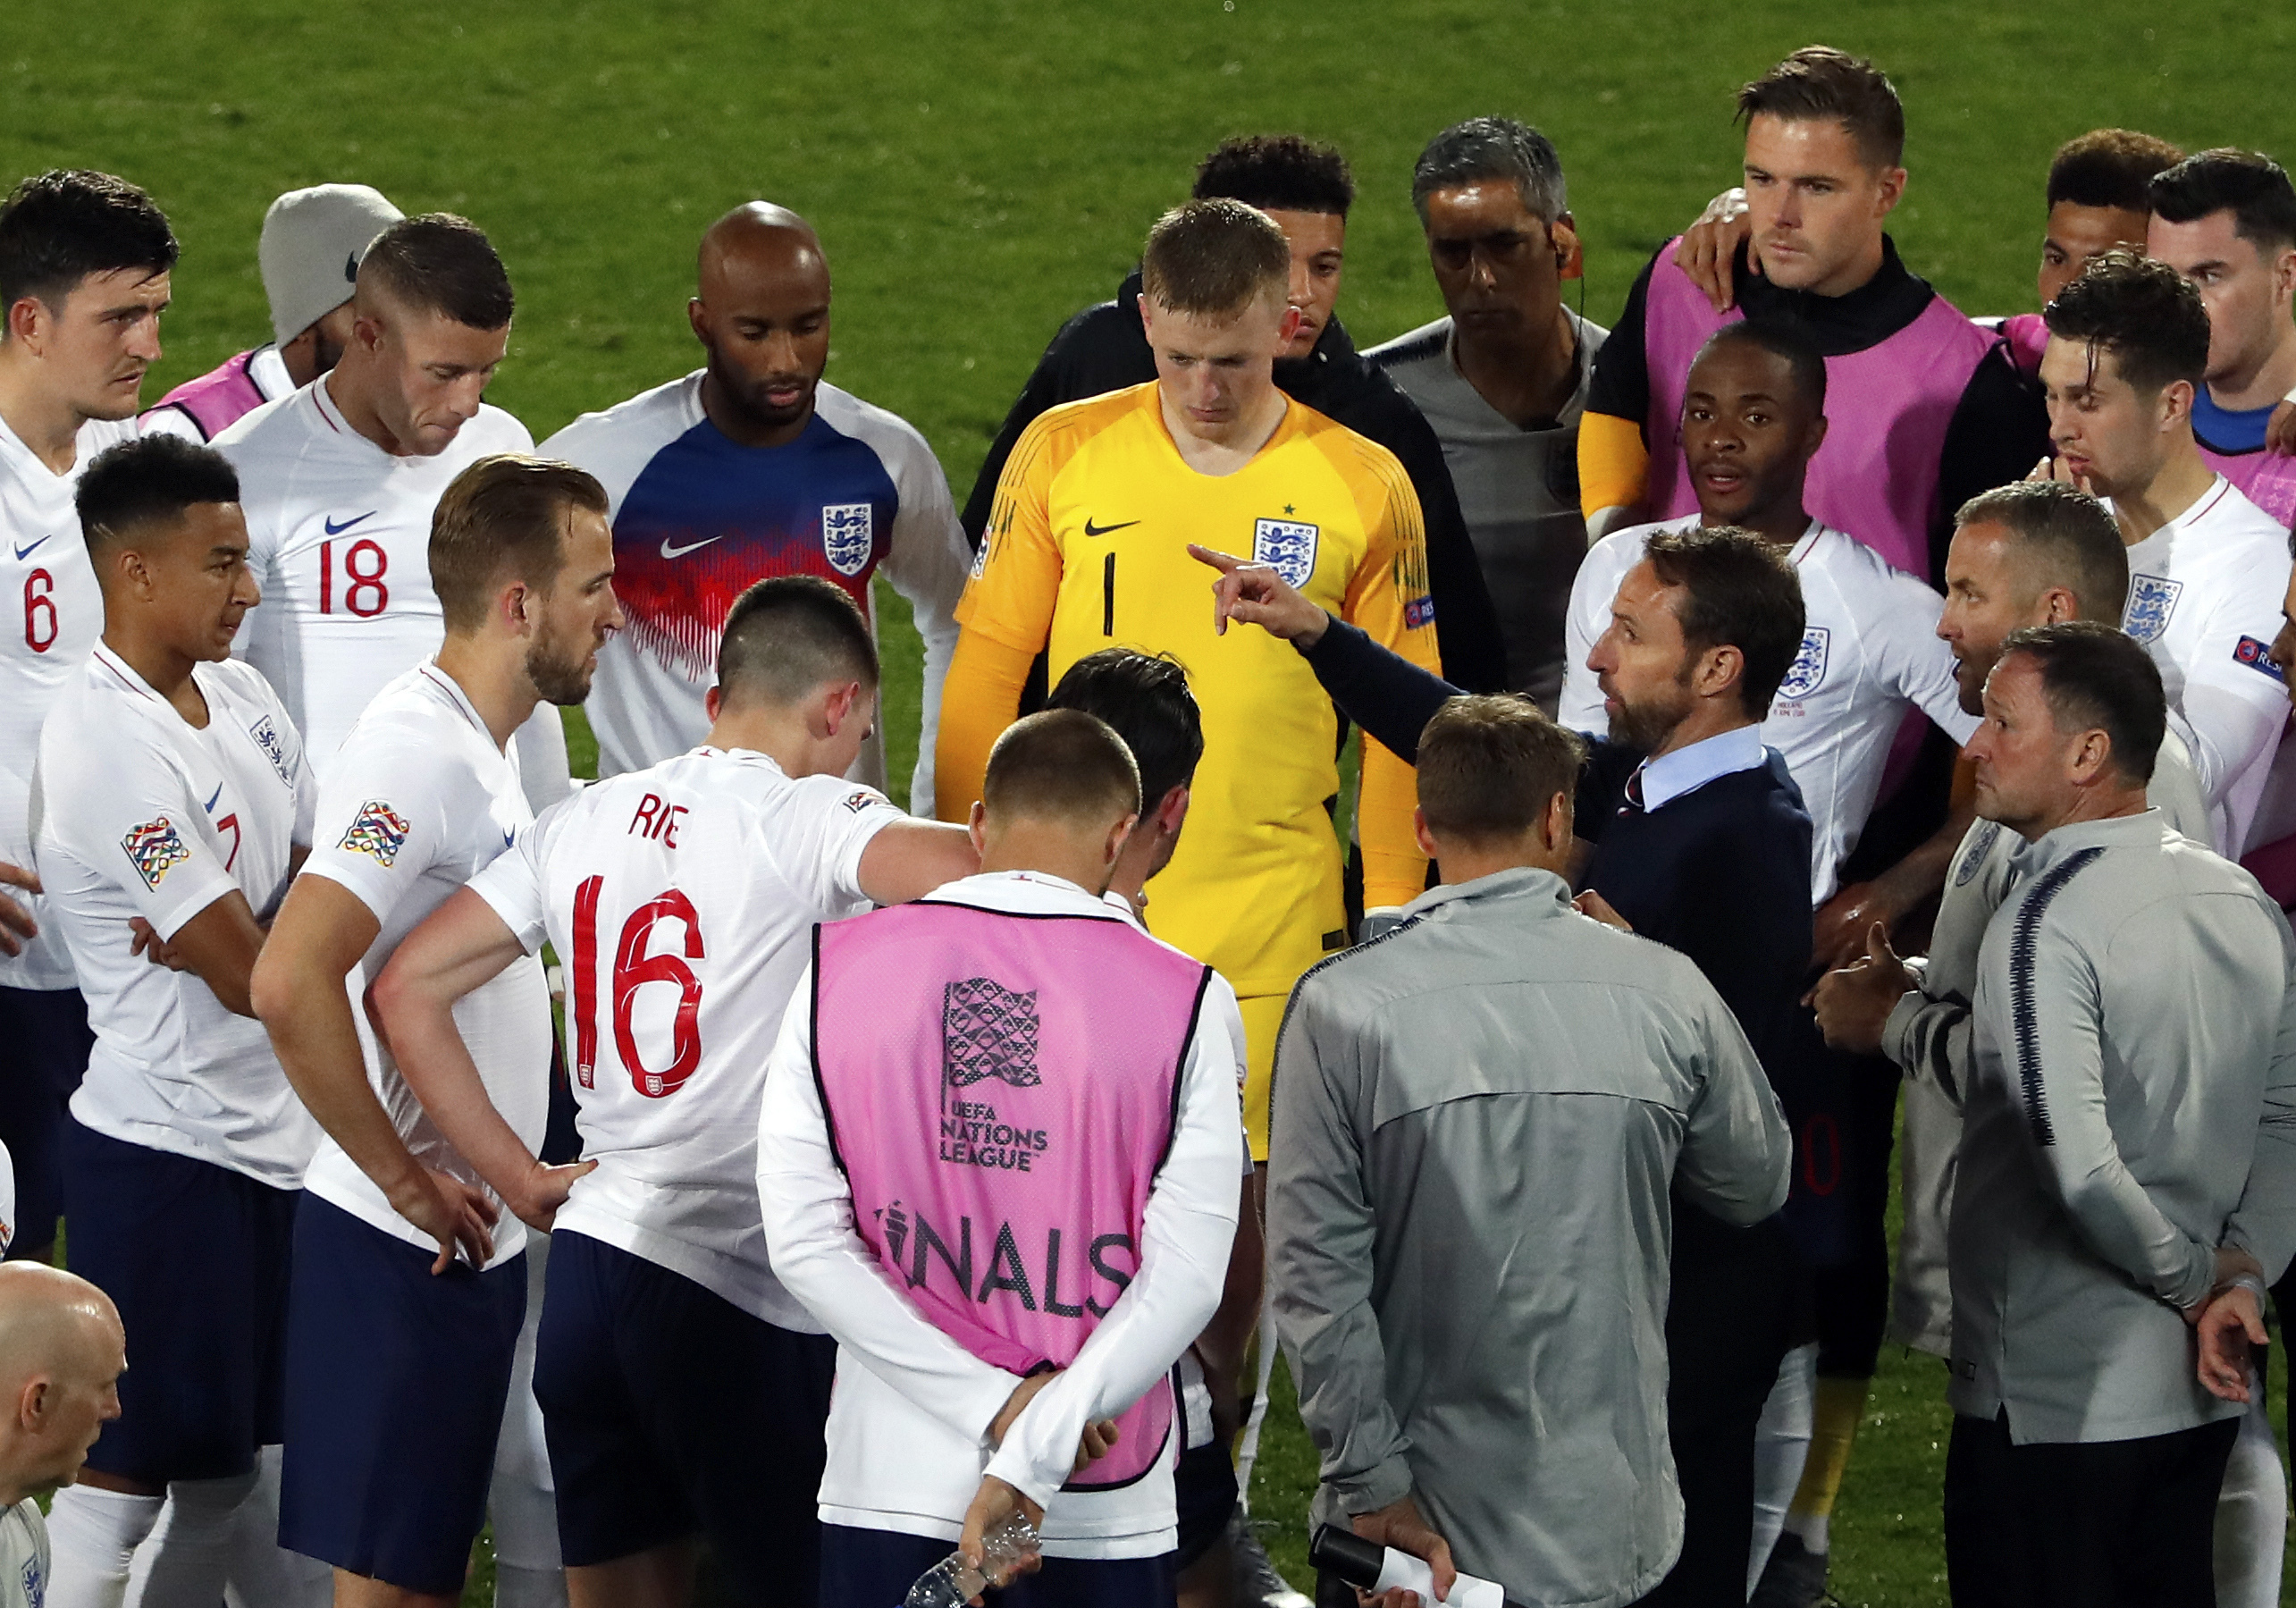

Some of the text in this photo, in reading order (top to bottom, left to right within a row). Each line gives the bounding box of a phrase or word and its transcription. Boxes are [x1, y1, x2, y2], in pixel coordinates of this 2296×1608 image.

[24, 568, 58, 653] 6
[320, 539, 389, 618] 18
[1103, 552, 1115, 637] 1
[217, 813, 240, 872] 7
[572, 875, 705, 1099] 16
[940, 1117, 1048, 1151] NATIONS
[952, 1100, 996, 1121] UEFA
[940, 1141, 1032, 1172] LEAGUE
